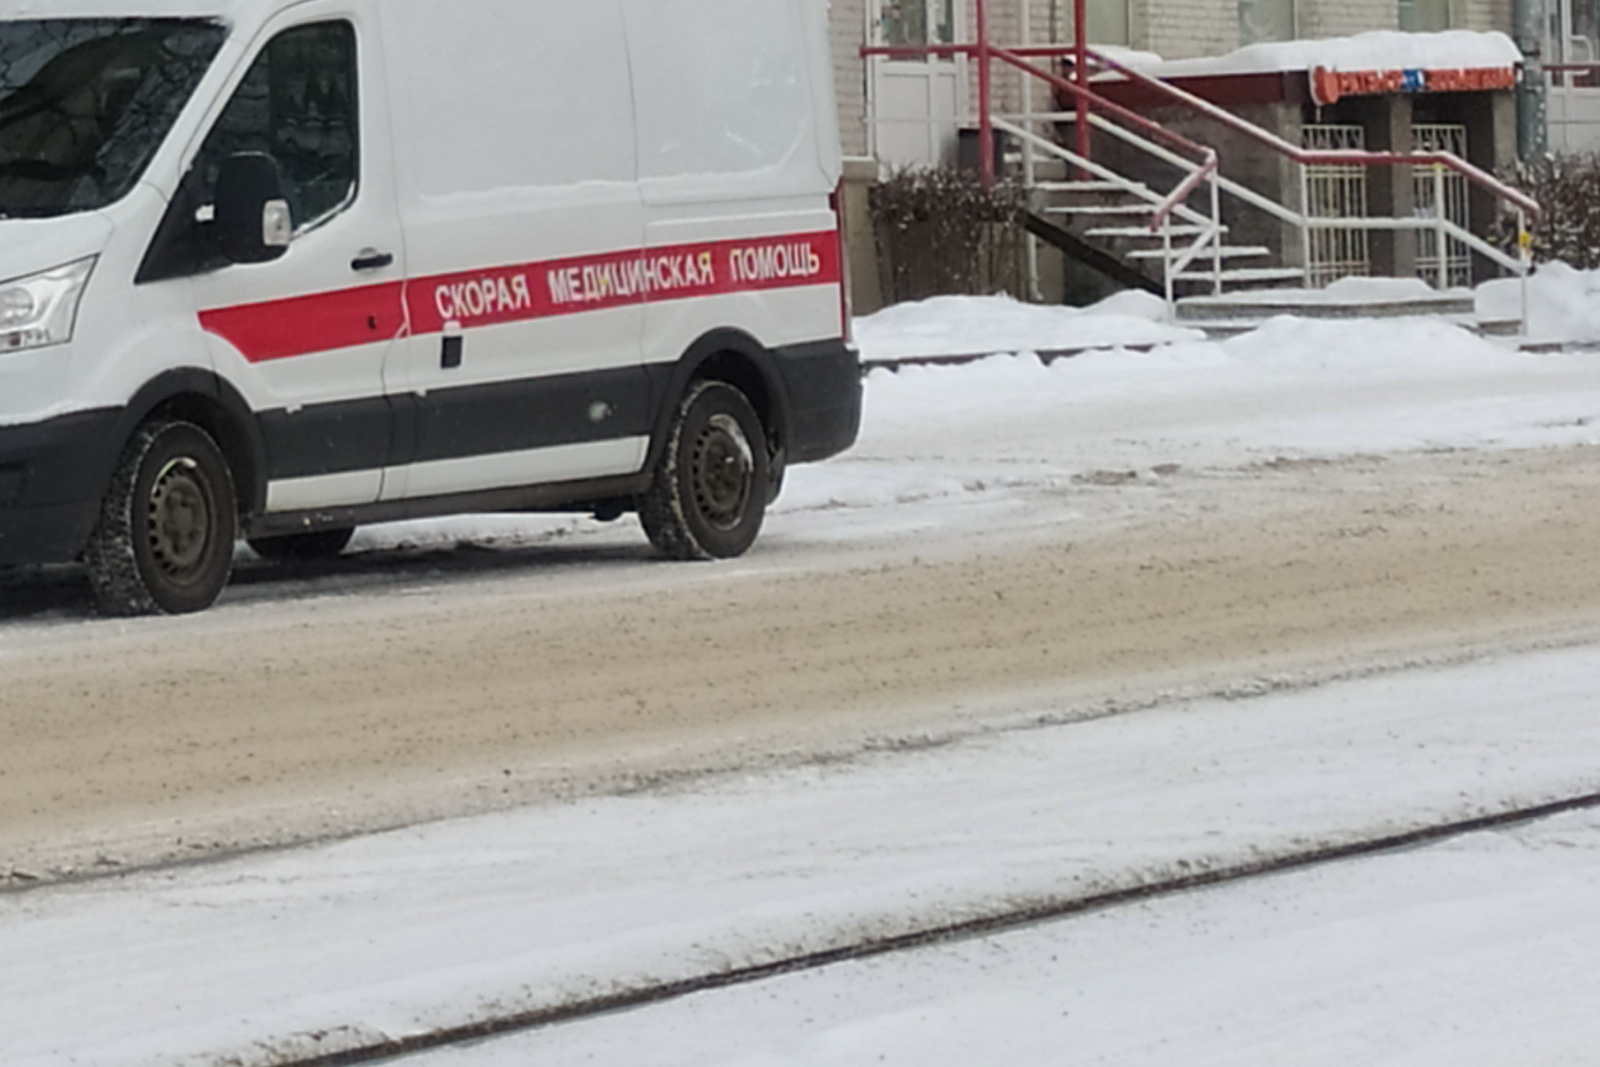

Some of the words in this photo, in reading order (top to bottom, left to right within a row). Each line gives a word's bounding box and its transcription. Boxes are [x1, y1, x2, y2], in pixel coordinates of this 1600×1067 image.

[435, 274, 531, 321] СКОРАЯ
[546, 250, 716, 305] МЕДИЦИНСКАЯ
[729, 241, 820, 283] ПОМОЩЬ
